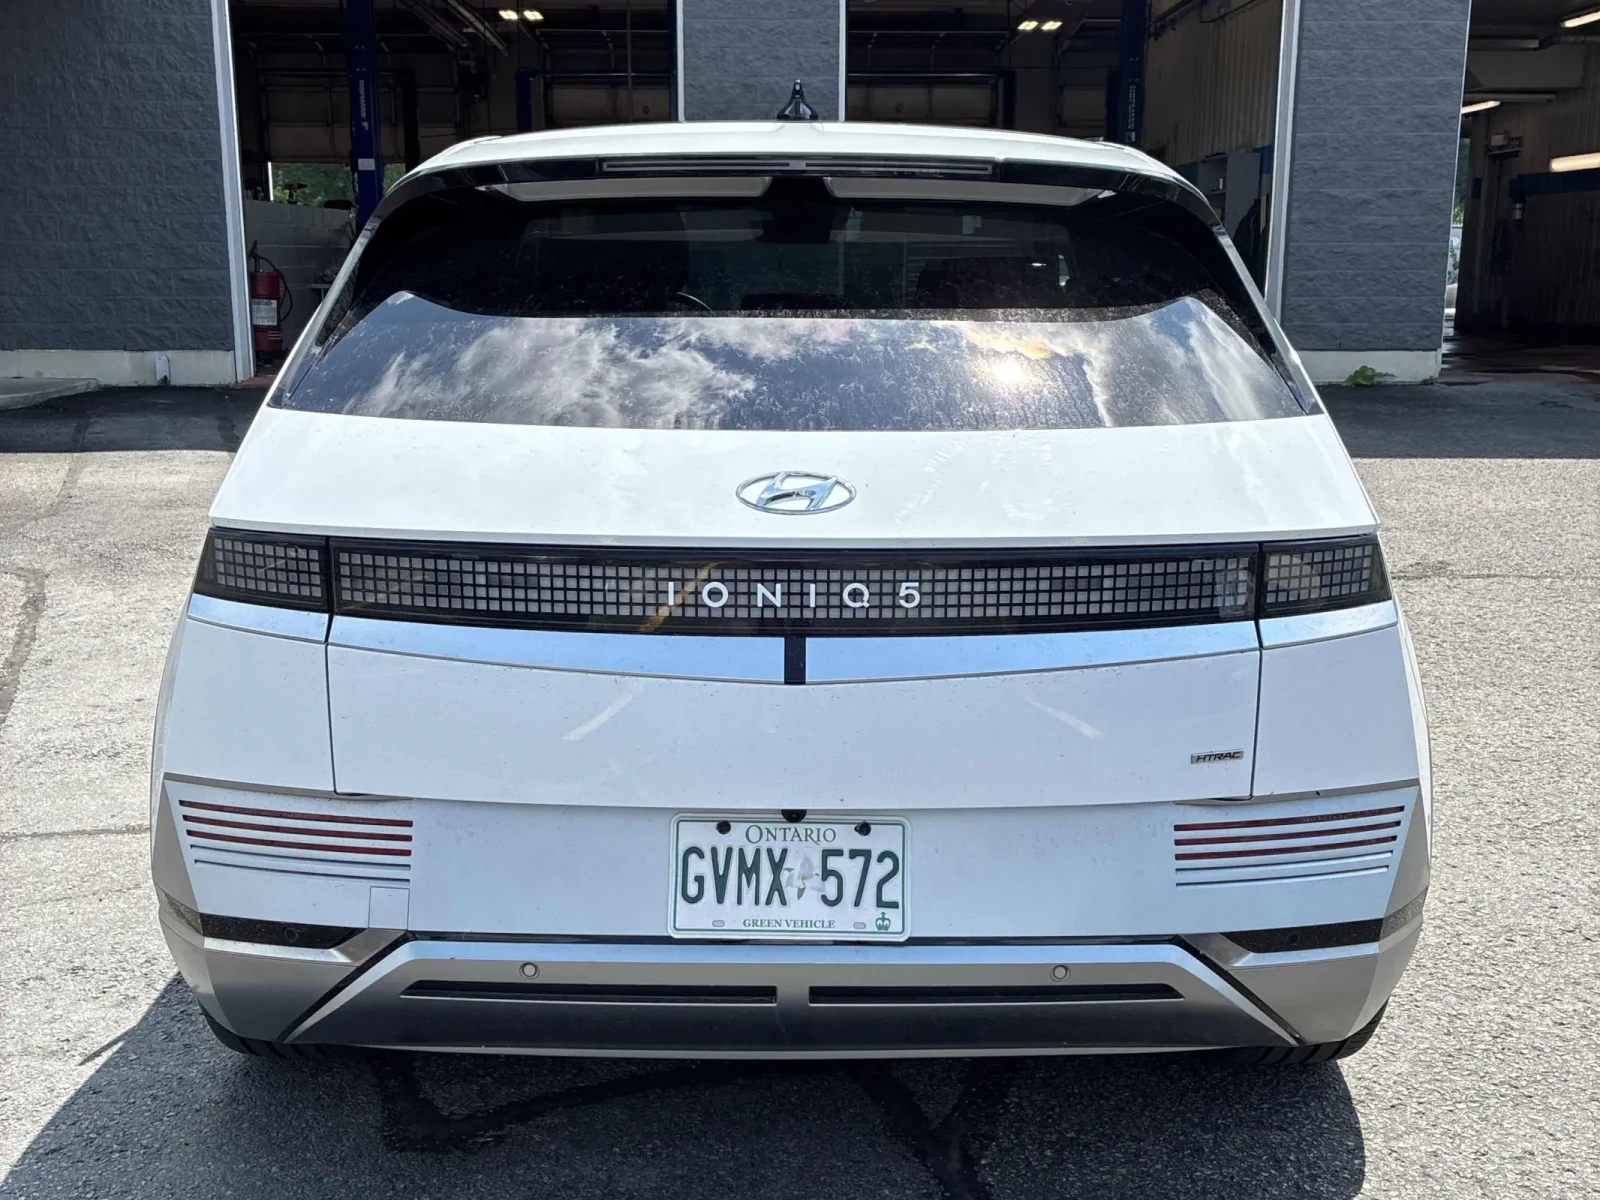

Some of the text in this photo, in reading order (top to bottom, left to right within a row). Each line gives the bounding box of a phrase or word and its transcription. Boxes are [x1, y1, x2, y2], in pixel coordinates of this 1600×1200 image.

[668, 581, 921, 608] IONIQ 5
[1195, 751, 1242, 762] HTRAC
[745, 824, 837, 845] ONTARIO
[681, 846, 900, 909] GVMX 572
[742, 918, 836, 929] GREEN VEHICLE
